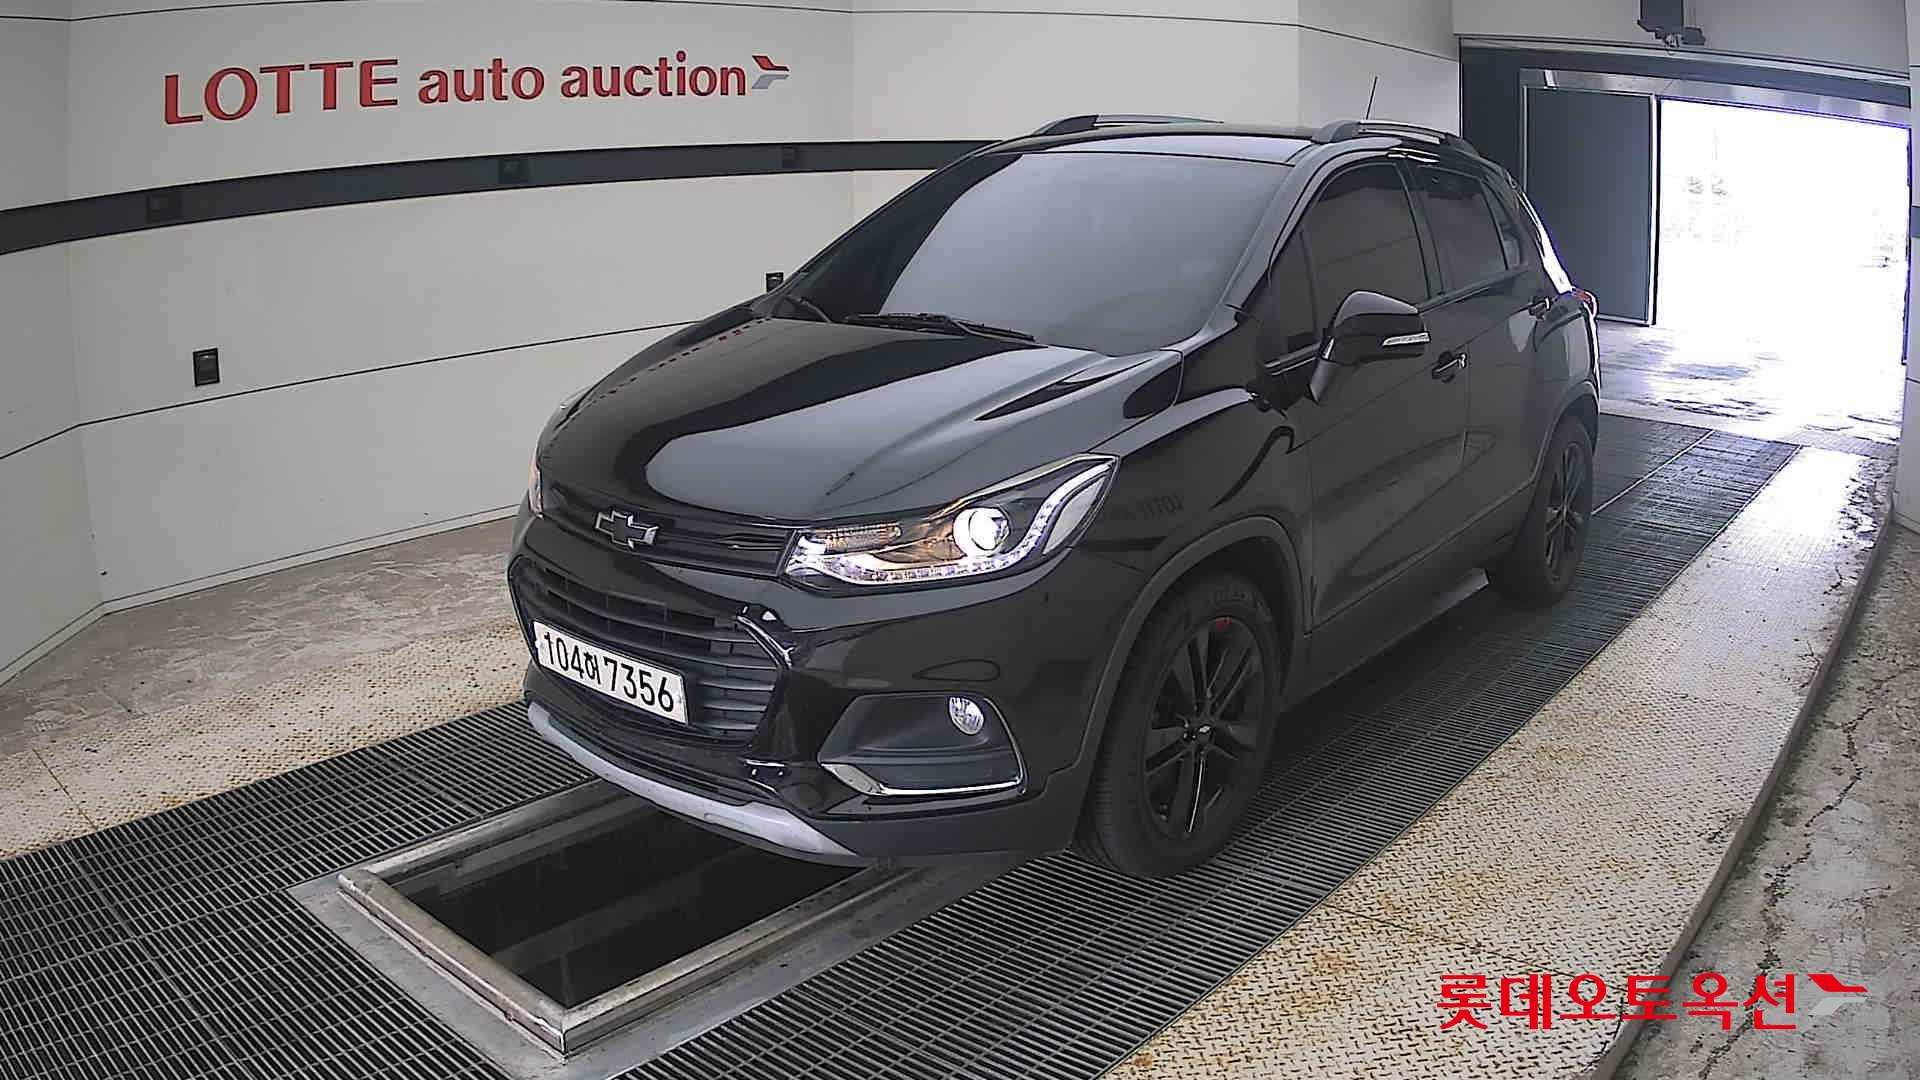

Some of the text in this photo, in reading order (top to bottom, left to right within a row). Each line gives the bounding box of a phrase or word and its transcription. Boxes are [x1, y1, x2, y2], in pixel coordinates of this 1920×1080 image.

[164, 51, 747, 126] LOTTE auto auction
